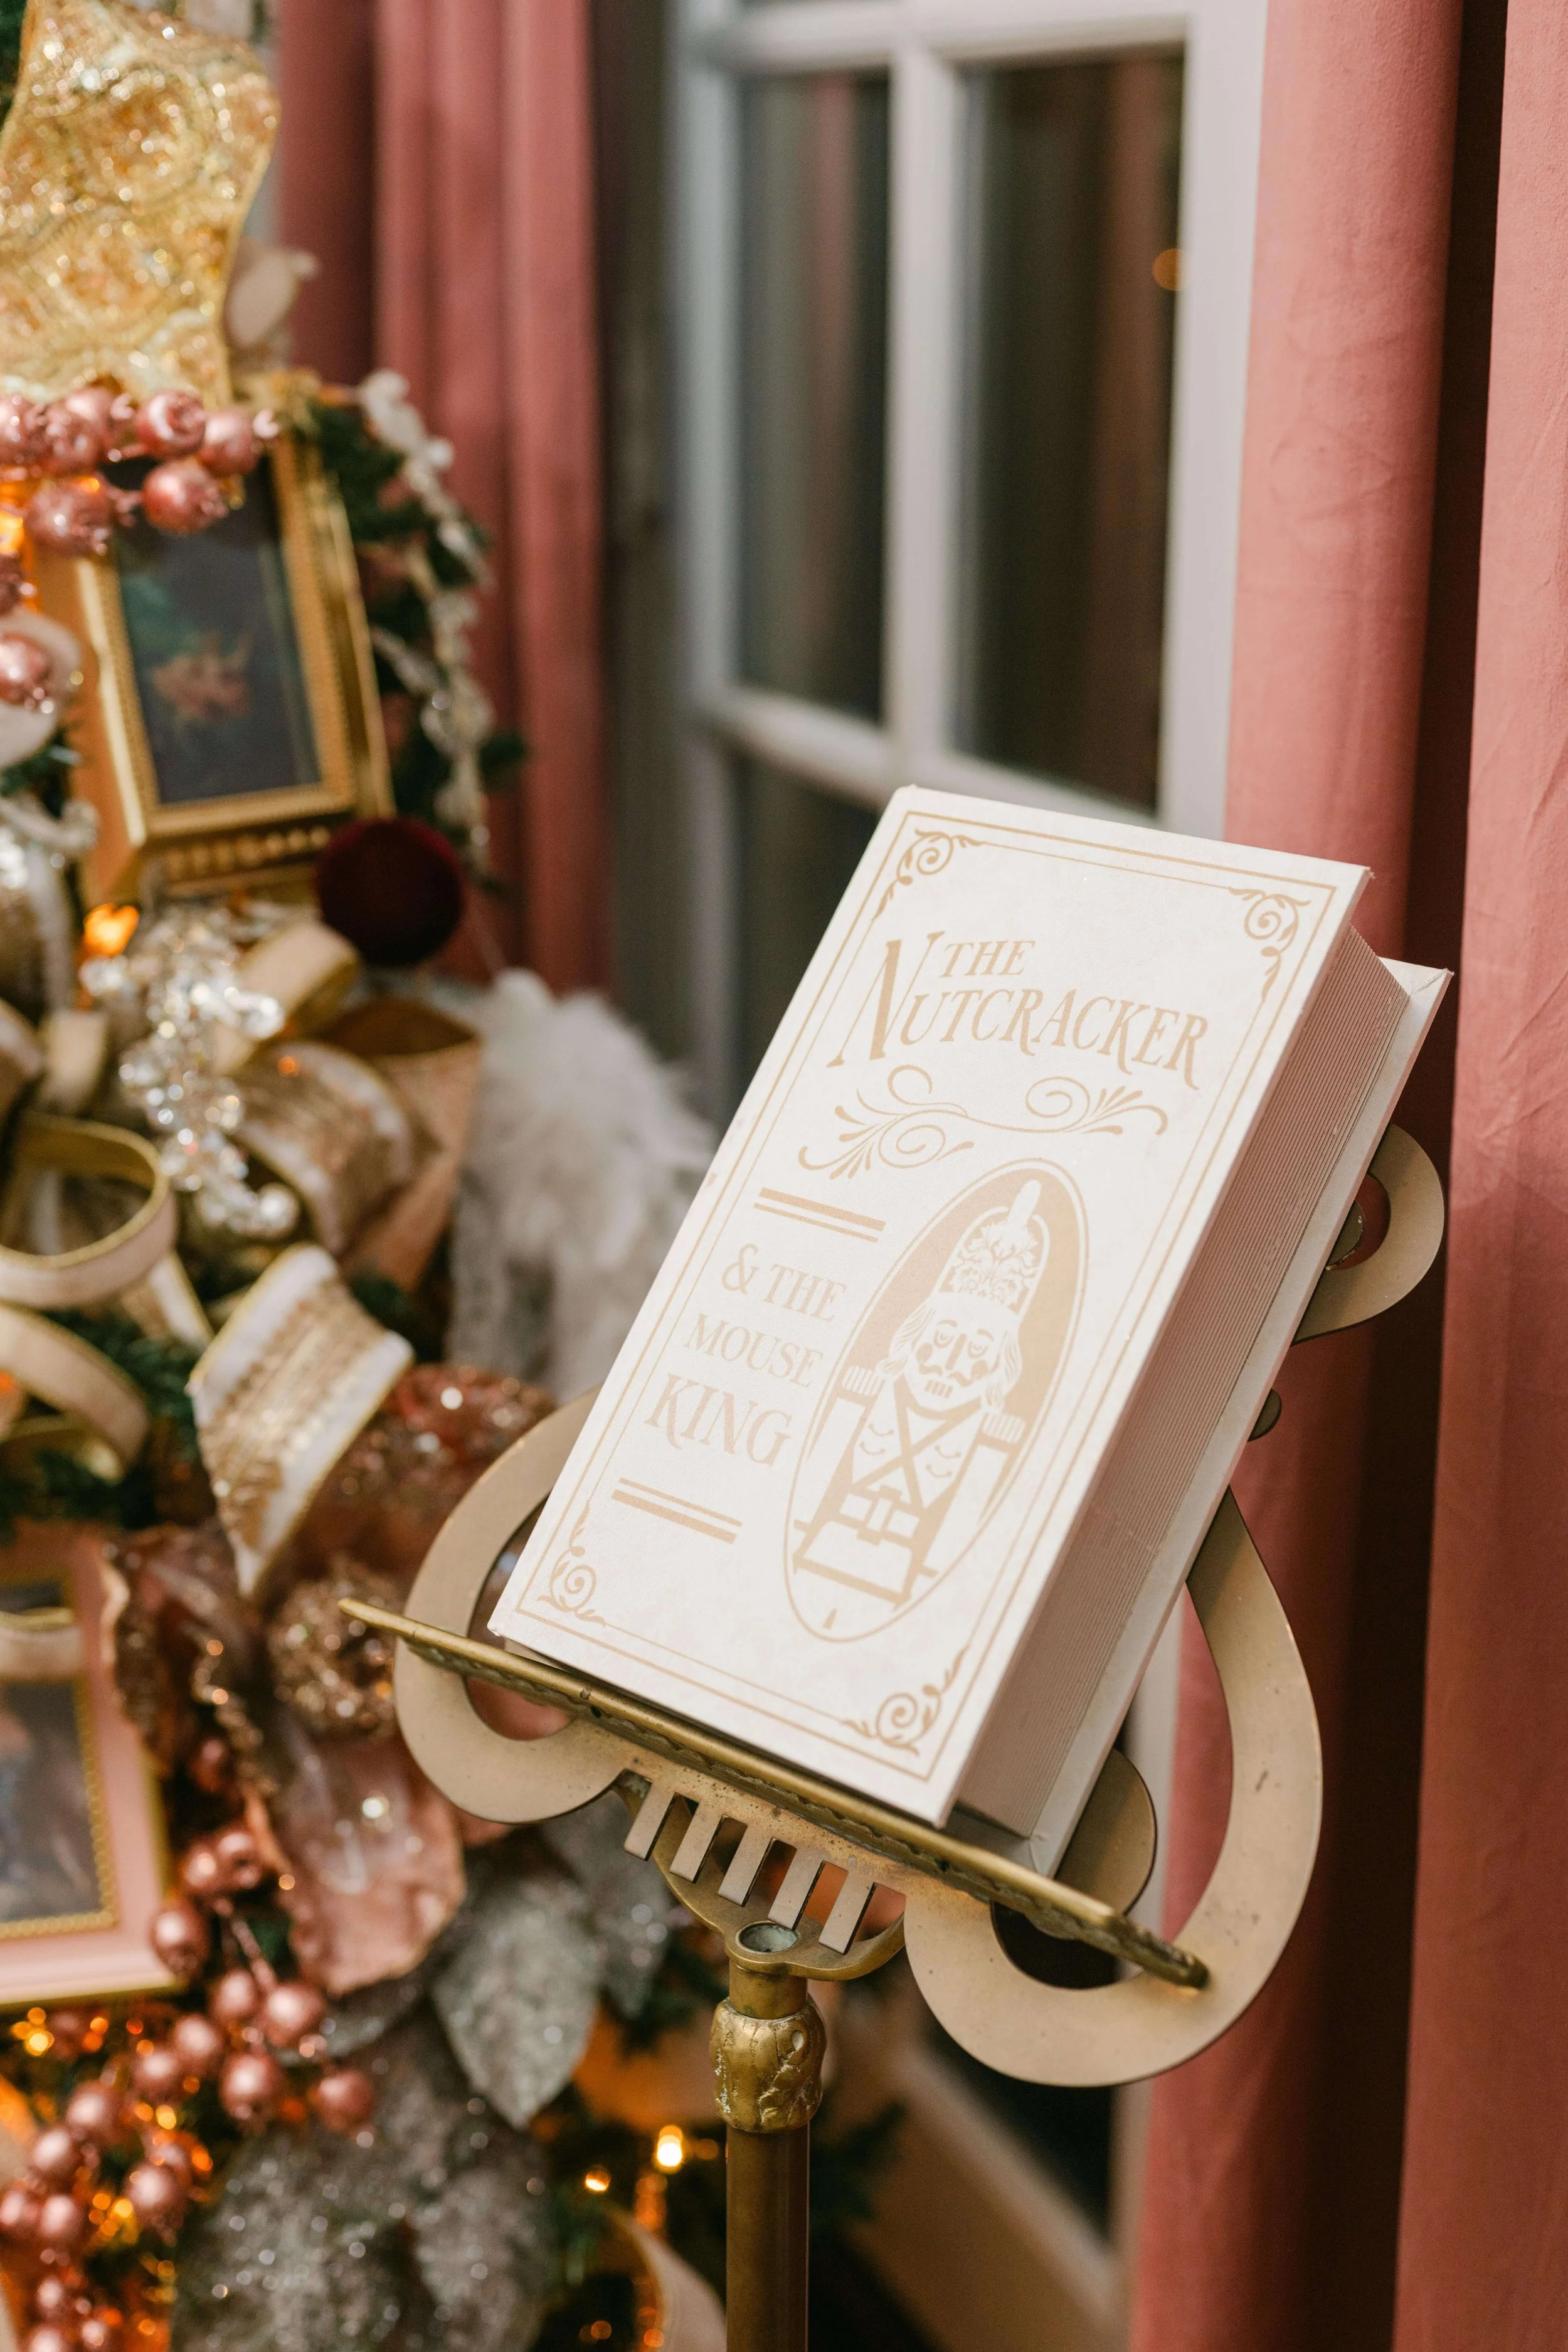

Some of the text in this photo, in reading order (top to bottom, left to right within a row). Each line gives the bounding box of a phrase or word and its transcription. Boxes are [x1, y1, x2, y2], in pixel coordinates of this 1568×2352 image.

[938, 939, 1036, 978] THE
[825, 930, 1209, 1091] NUTCRACKER
[721, 1243, 848, 1322] & THE
[683, 1313, 824, 1388] MOUSE
[644, 1372, 793, 1468] KING
